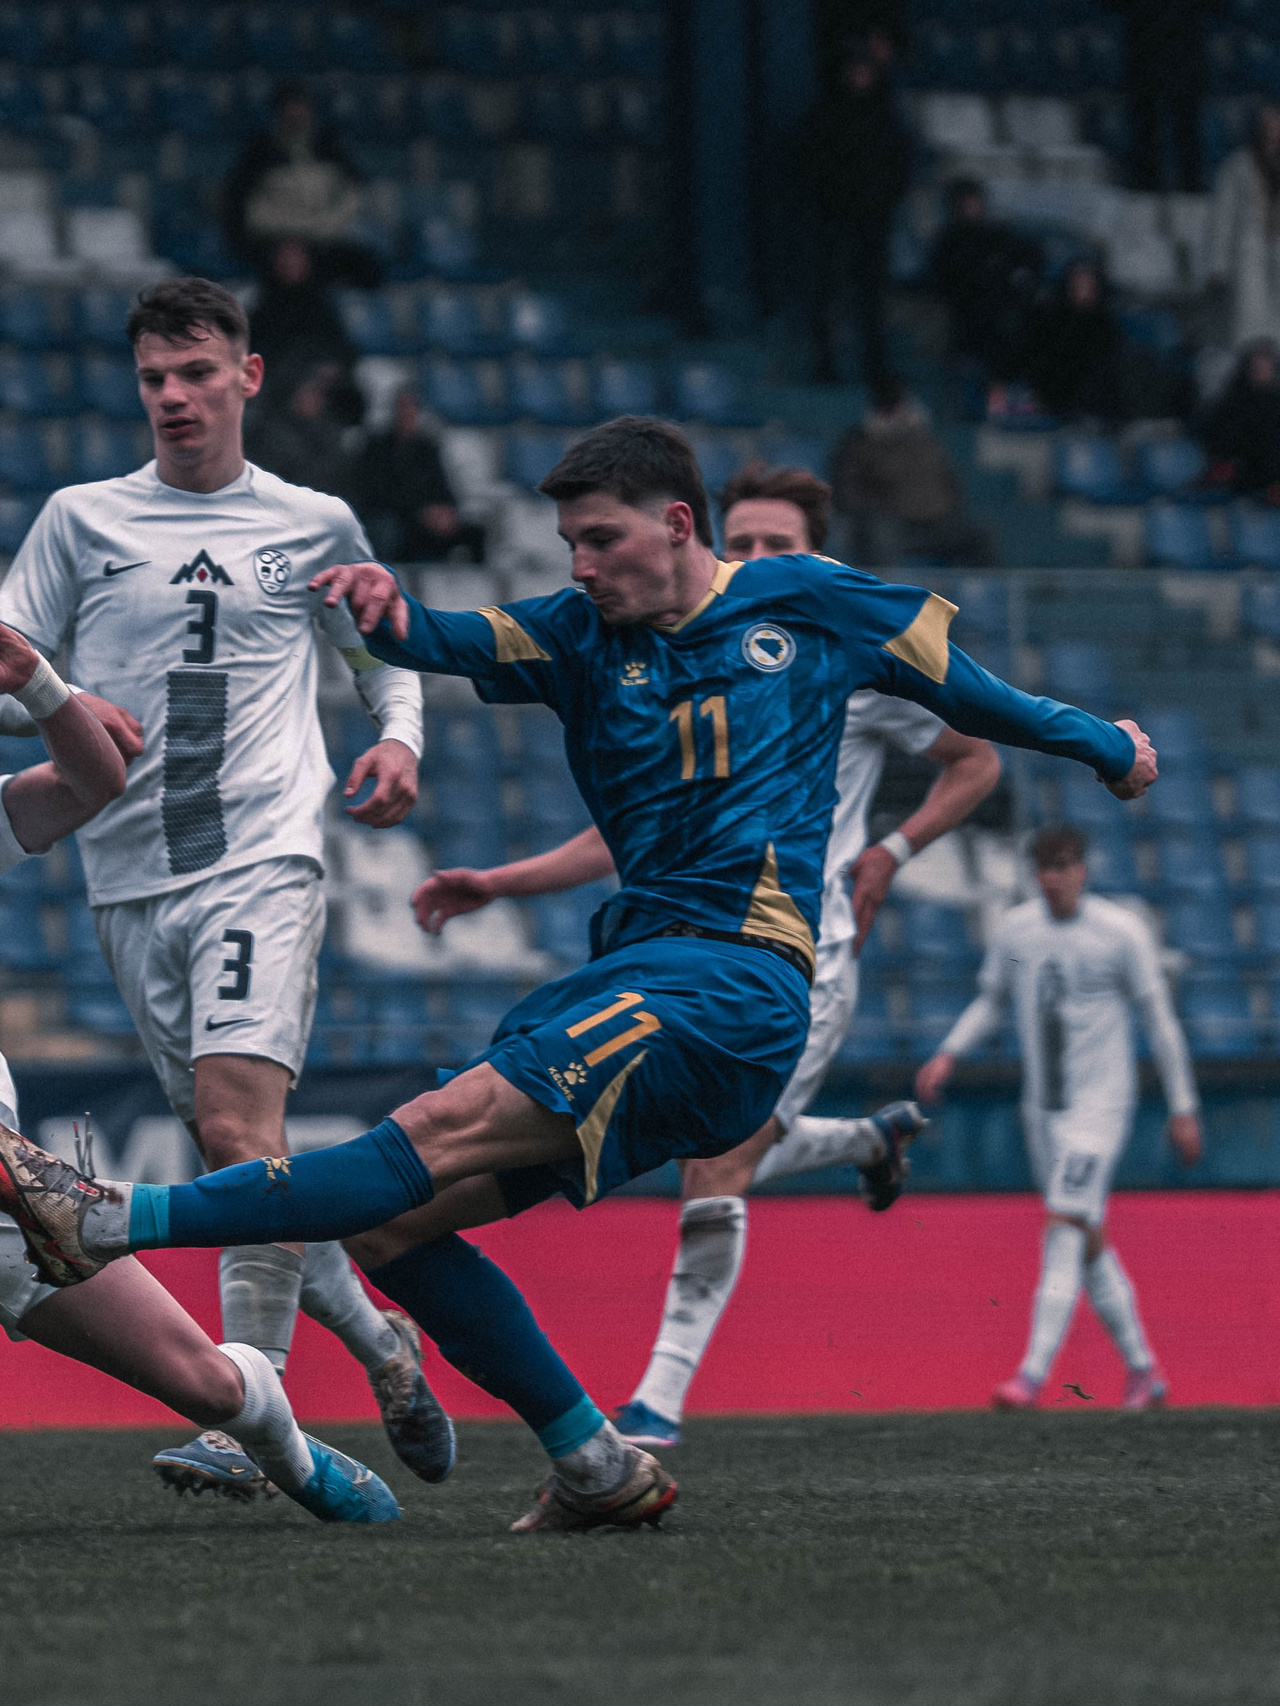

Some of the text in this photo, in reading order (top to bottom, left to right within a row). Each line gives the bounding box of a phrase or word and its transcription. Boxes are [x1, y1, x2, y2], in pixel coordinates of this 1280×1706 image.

[181, 589, 219, 664] 3
[669, 695, 730, 781] 11
[217, 928, 255, 1001] 3
[564, 991, 663, 1068] 11
[547, 1065, 576, 1102] KELME
